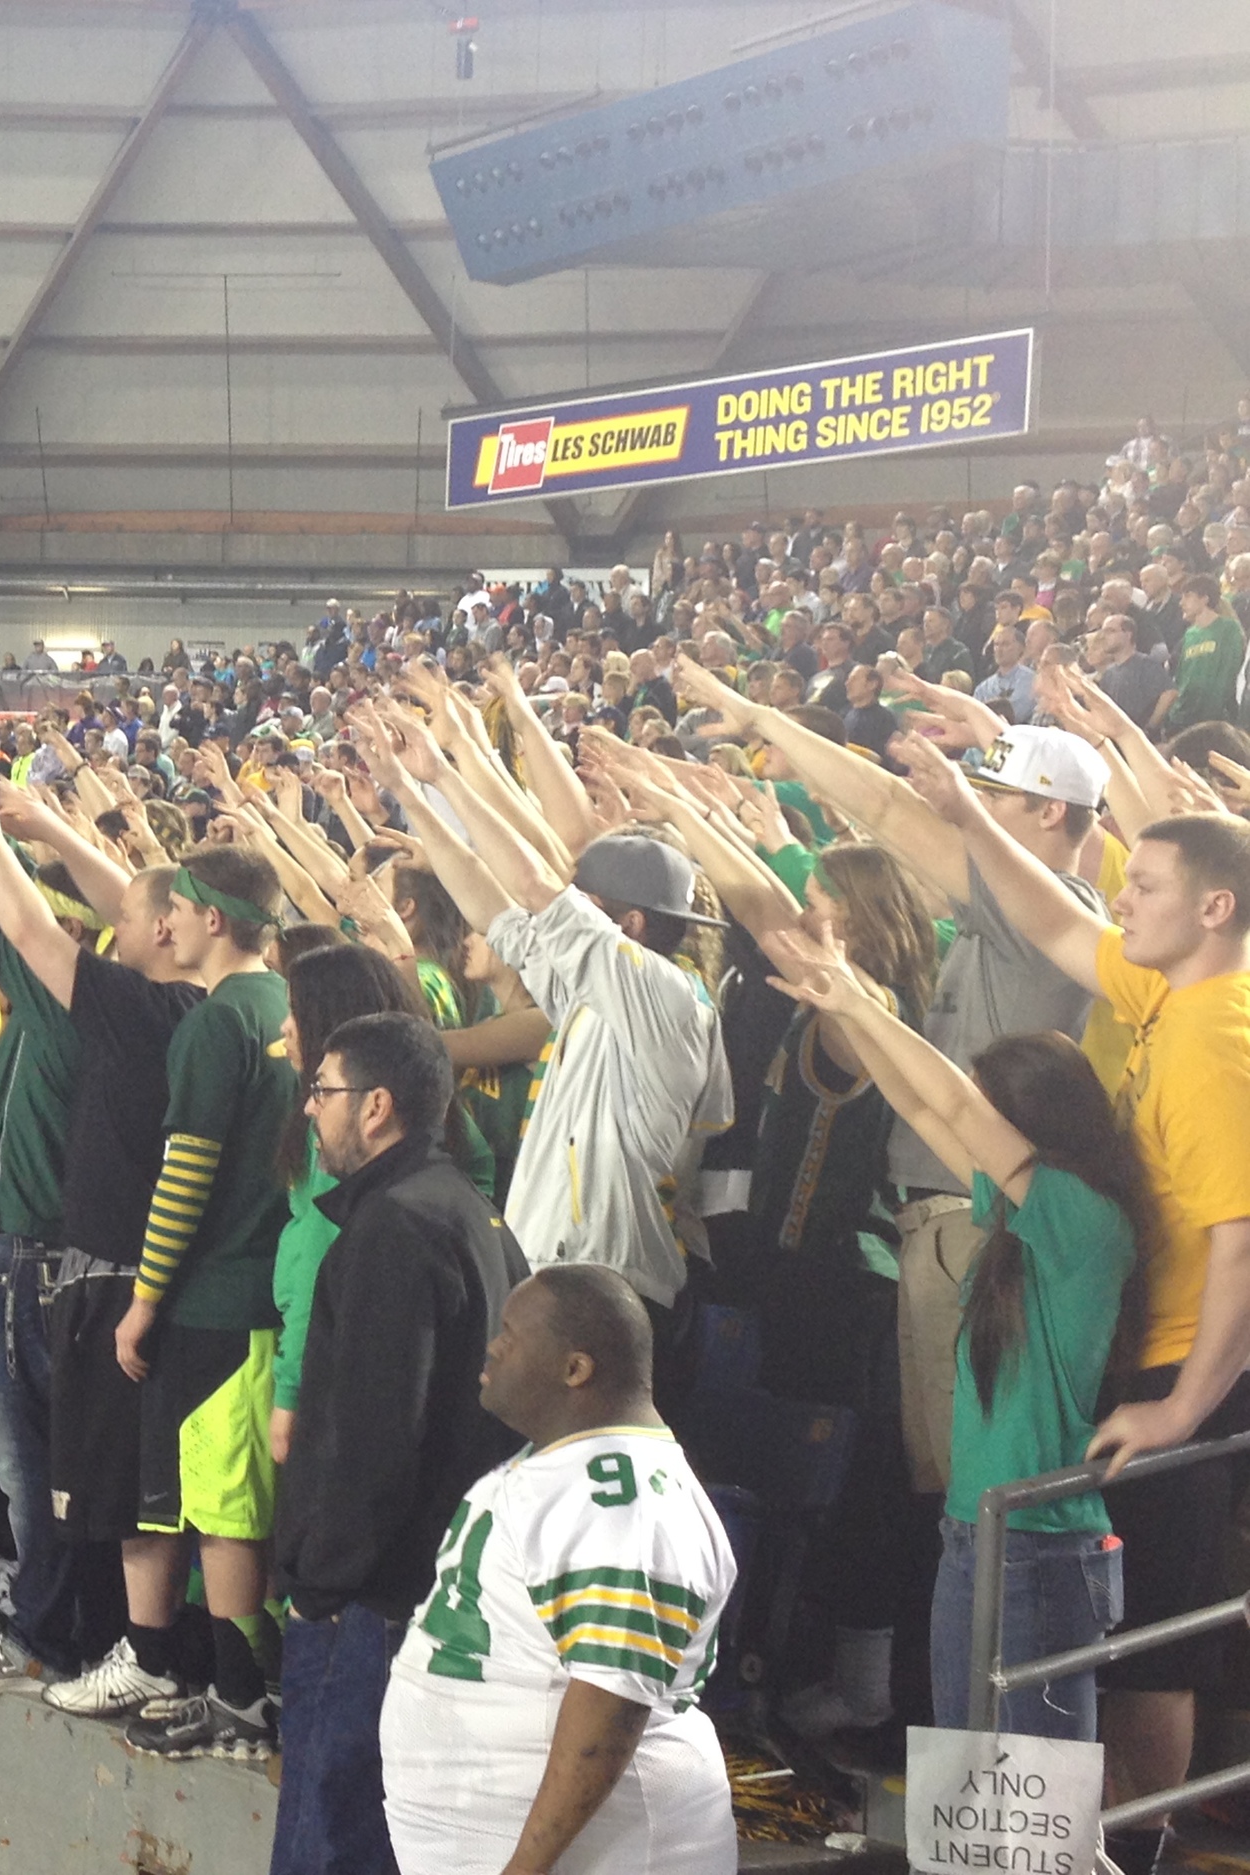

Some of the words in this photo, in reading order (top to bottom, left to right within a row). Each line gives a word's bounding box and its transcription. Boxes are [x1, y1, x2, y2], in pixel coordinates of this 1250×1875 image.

[716, 382, 812, 426] DOING
[820, 371, 884, 417] THE
[892, 354, 995, 400] RIGHT
[551, 434, 584, 463] LES
[588, 422, 678, 457] SCHWAB
[714, 420, 808, 461] THING
[815, 405, 911, 449] SINCE
[920, 394, 992, 433] 1952
[498, 433, 547, 475] Tires
[586, 1452, 638, 1508] 9
[959, 1770, 1047, 1799] ONLY
[933, 1804, 1072, 1840] SECTION
[929, 1840, 1074, 1875] STUDENT
